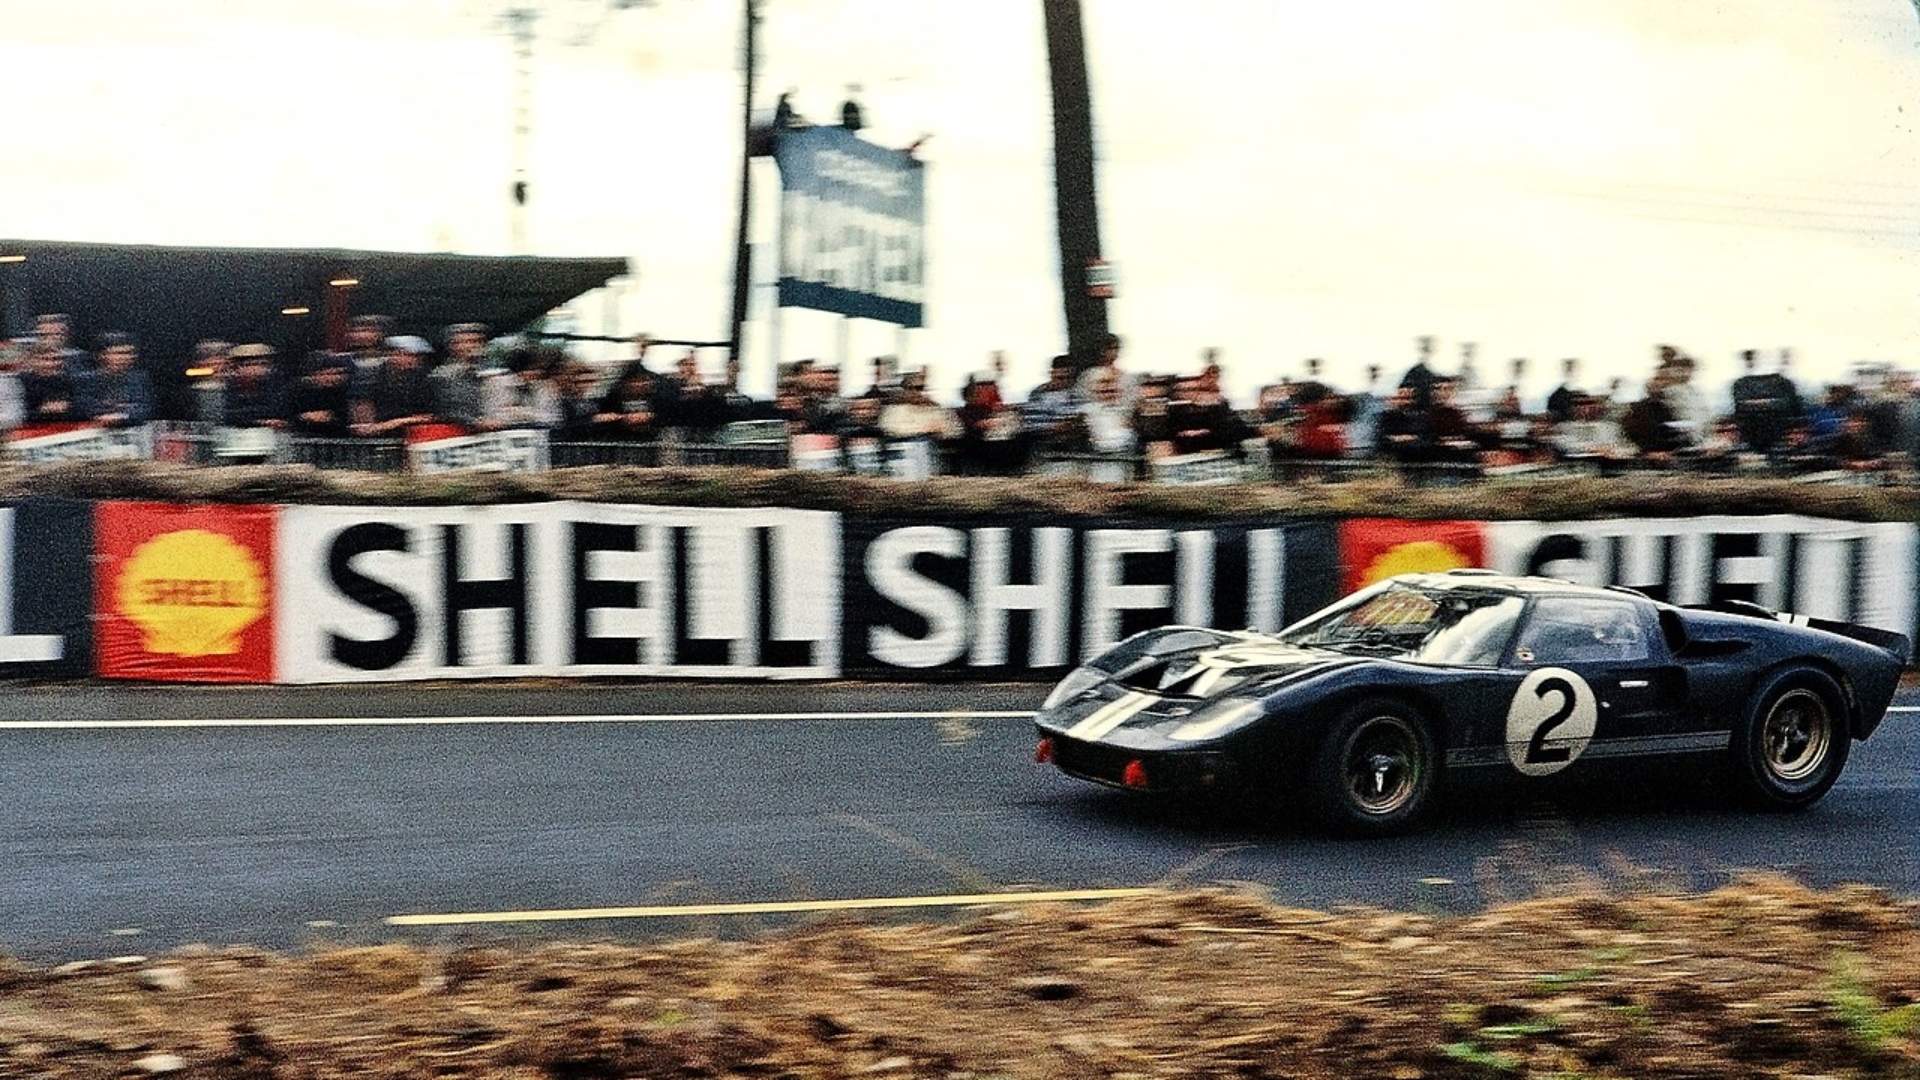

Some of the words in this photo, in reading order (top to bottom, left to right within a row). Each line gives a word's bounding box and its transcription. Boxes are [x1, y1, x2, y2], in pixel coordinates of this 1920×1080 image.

[139, 578, 247, 608] SHELL
[328, 521, 819, 671] SHELL
[1524, 676, 1577, 765] 2
